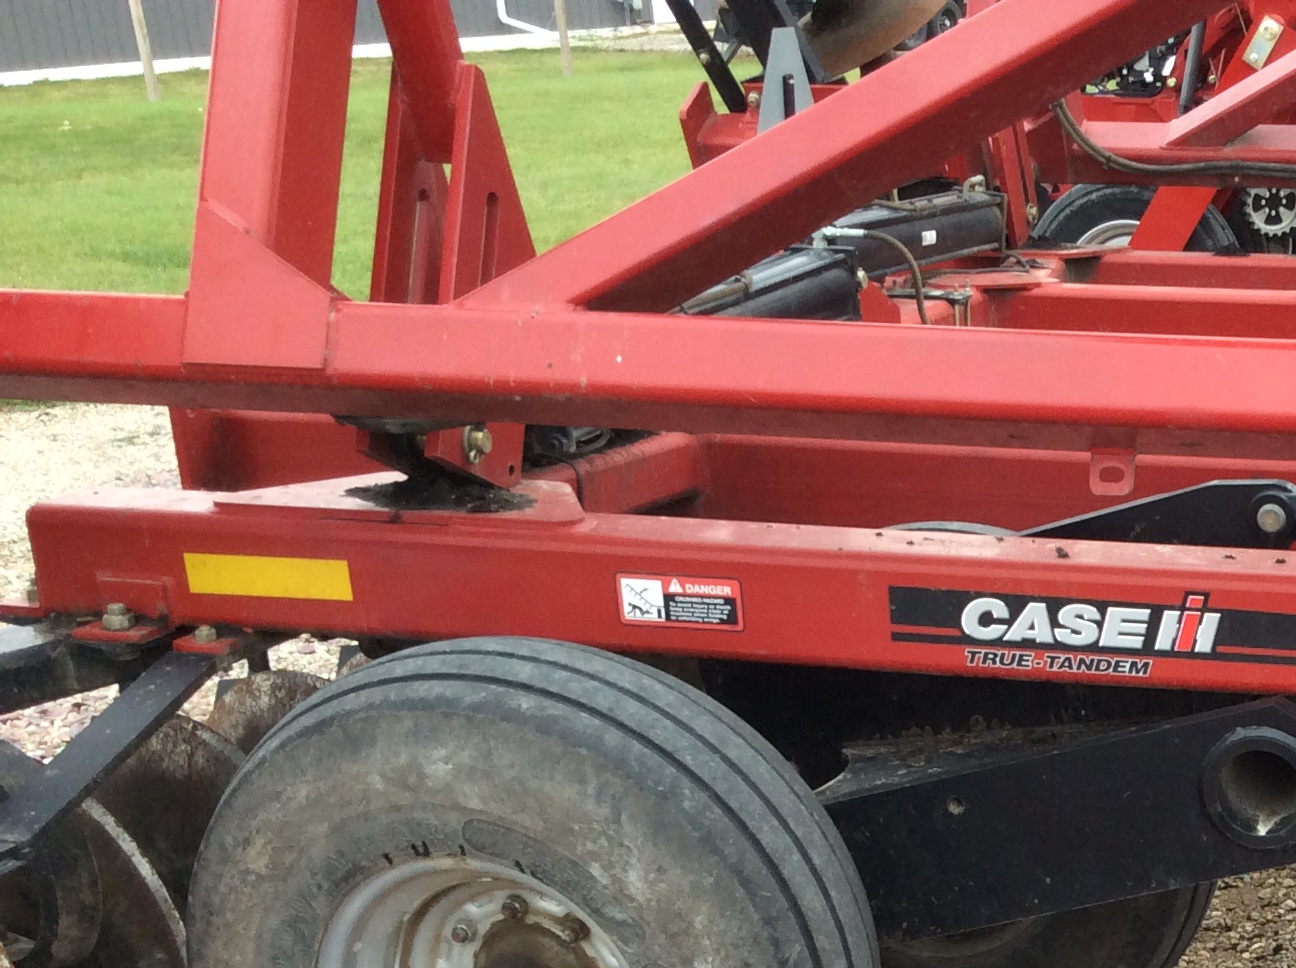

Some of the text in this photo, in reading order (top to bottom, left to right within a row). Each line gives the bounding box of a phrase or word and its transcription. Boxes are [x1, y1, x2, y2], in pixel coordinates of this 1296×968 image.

[685, 584, 732, 595] DANGER
[961, 597, 1151, 649] CASE
[965, 648, 1152, 676] TRUE-TANDEM
